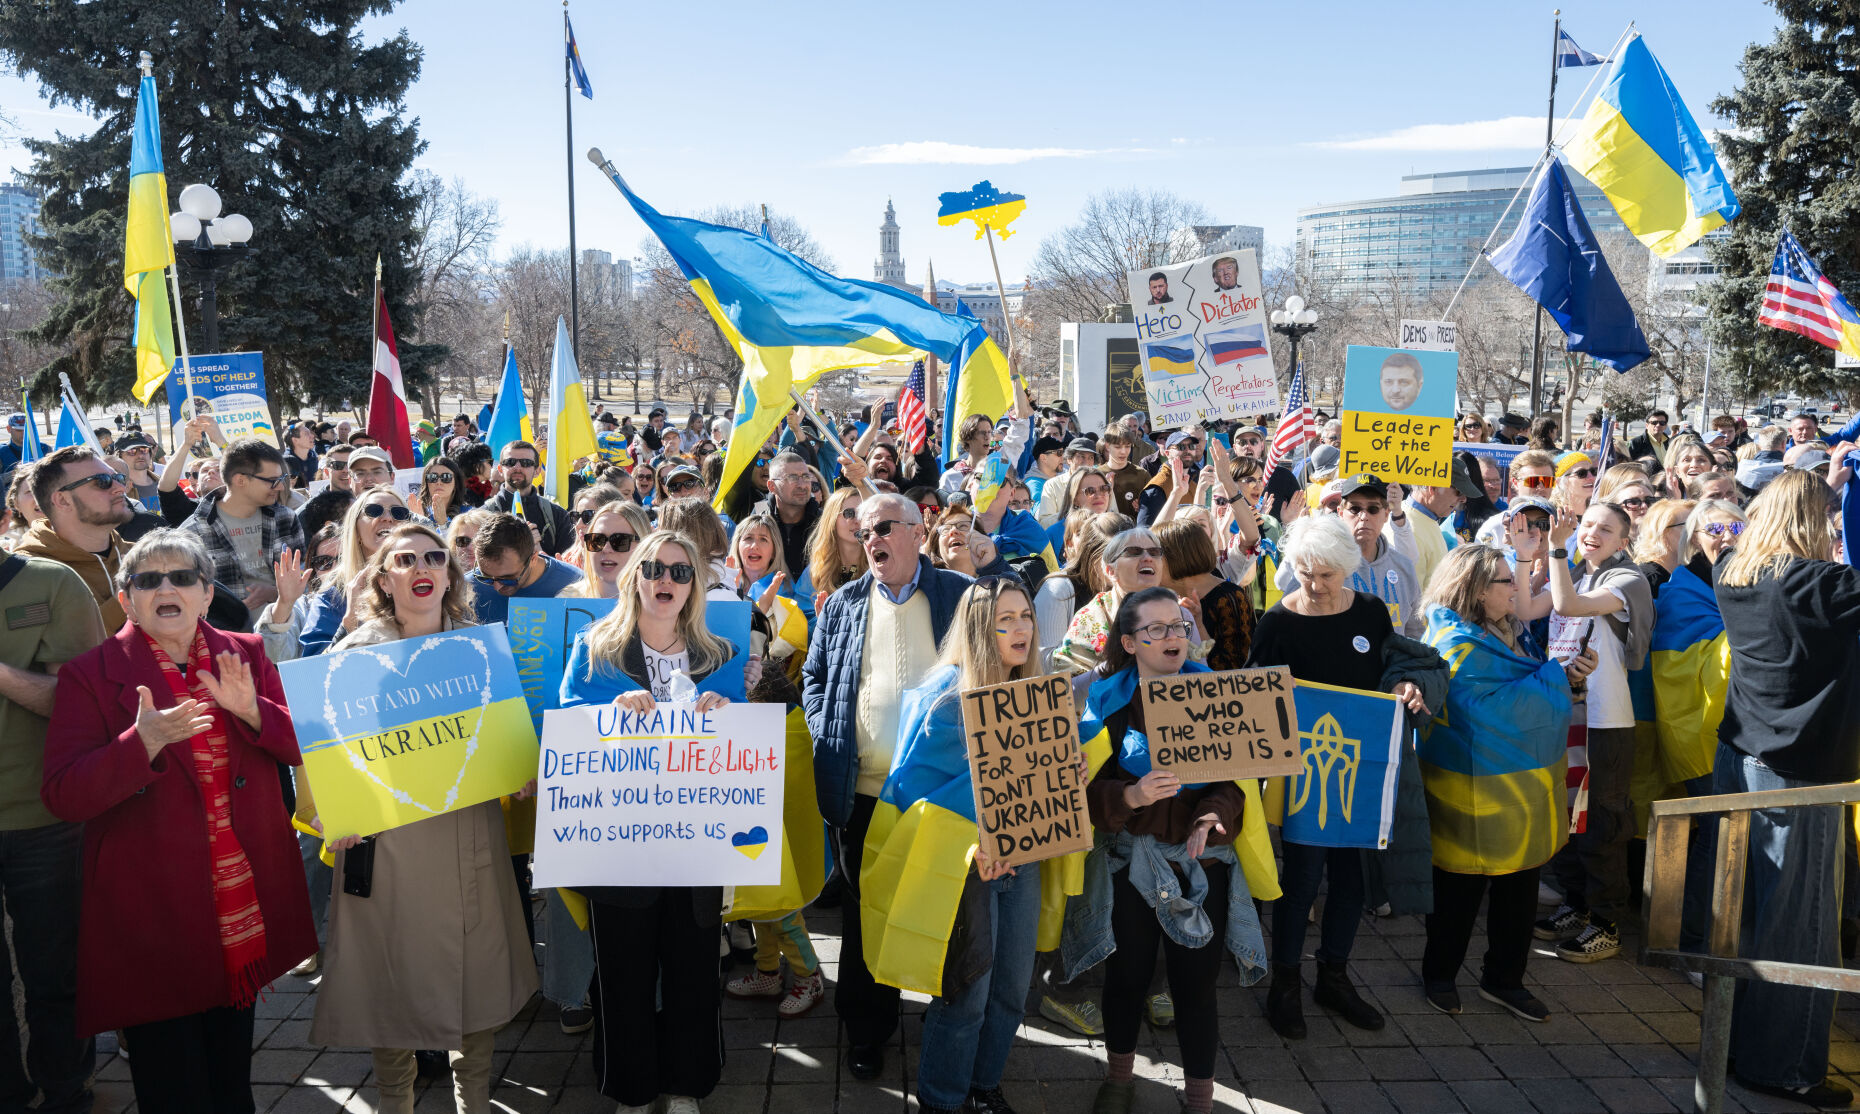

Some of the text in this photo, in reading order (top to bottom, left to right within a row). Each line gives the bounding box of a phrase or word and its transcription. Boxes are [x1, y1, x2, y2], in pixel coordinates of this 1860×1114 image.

[1201, 293, 1260, 324] Dictator
[1135, 313, 1182, 339] Hero
[1403, 325, 1427, 343] DEMS
[1437, 326, 1455, 344] PRESS
[198, 365, 229, 373] SPREAD
[213, 374, 227, 382] OF
[230, 372, 256, 381] HELP
[214, 382, 258, 392] TOGETHER!
[1147, 384, 1203, 405] Victims
[212, 410, 263, 424] REEDOM
[1156, 399, 1277, 426] STAND WITH UKRAINE
[226, 427, 248, 437] FOR
[1355, 413, 1441, 436] Leader
[1372, 436, 1430, 451] of the
[1345, 451, 1448, 478] Free World
[229, 525, 262, 536] URI CLIF
[344, 674, 480, 719] I STAND WITH
[598, 707, 717, 736] UKRAINE
[1185, 700, 1243, 722] WHO
[359, 716, 470, 761] UKRAINE
[972, 731, 989, 758] I
[544, 746, 660, 778] DEFENDING
[1046, 763, 1081, 793] LET
[652, 784, 673, 806] to
[981, 789, 1082, 834] UKRAINE
